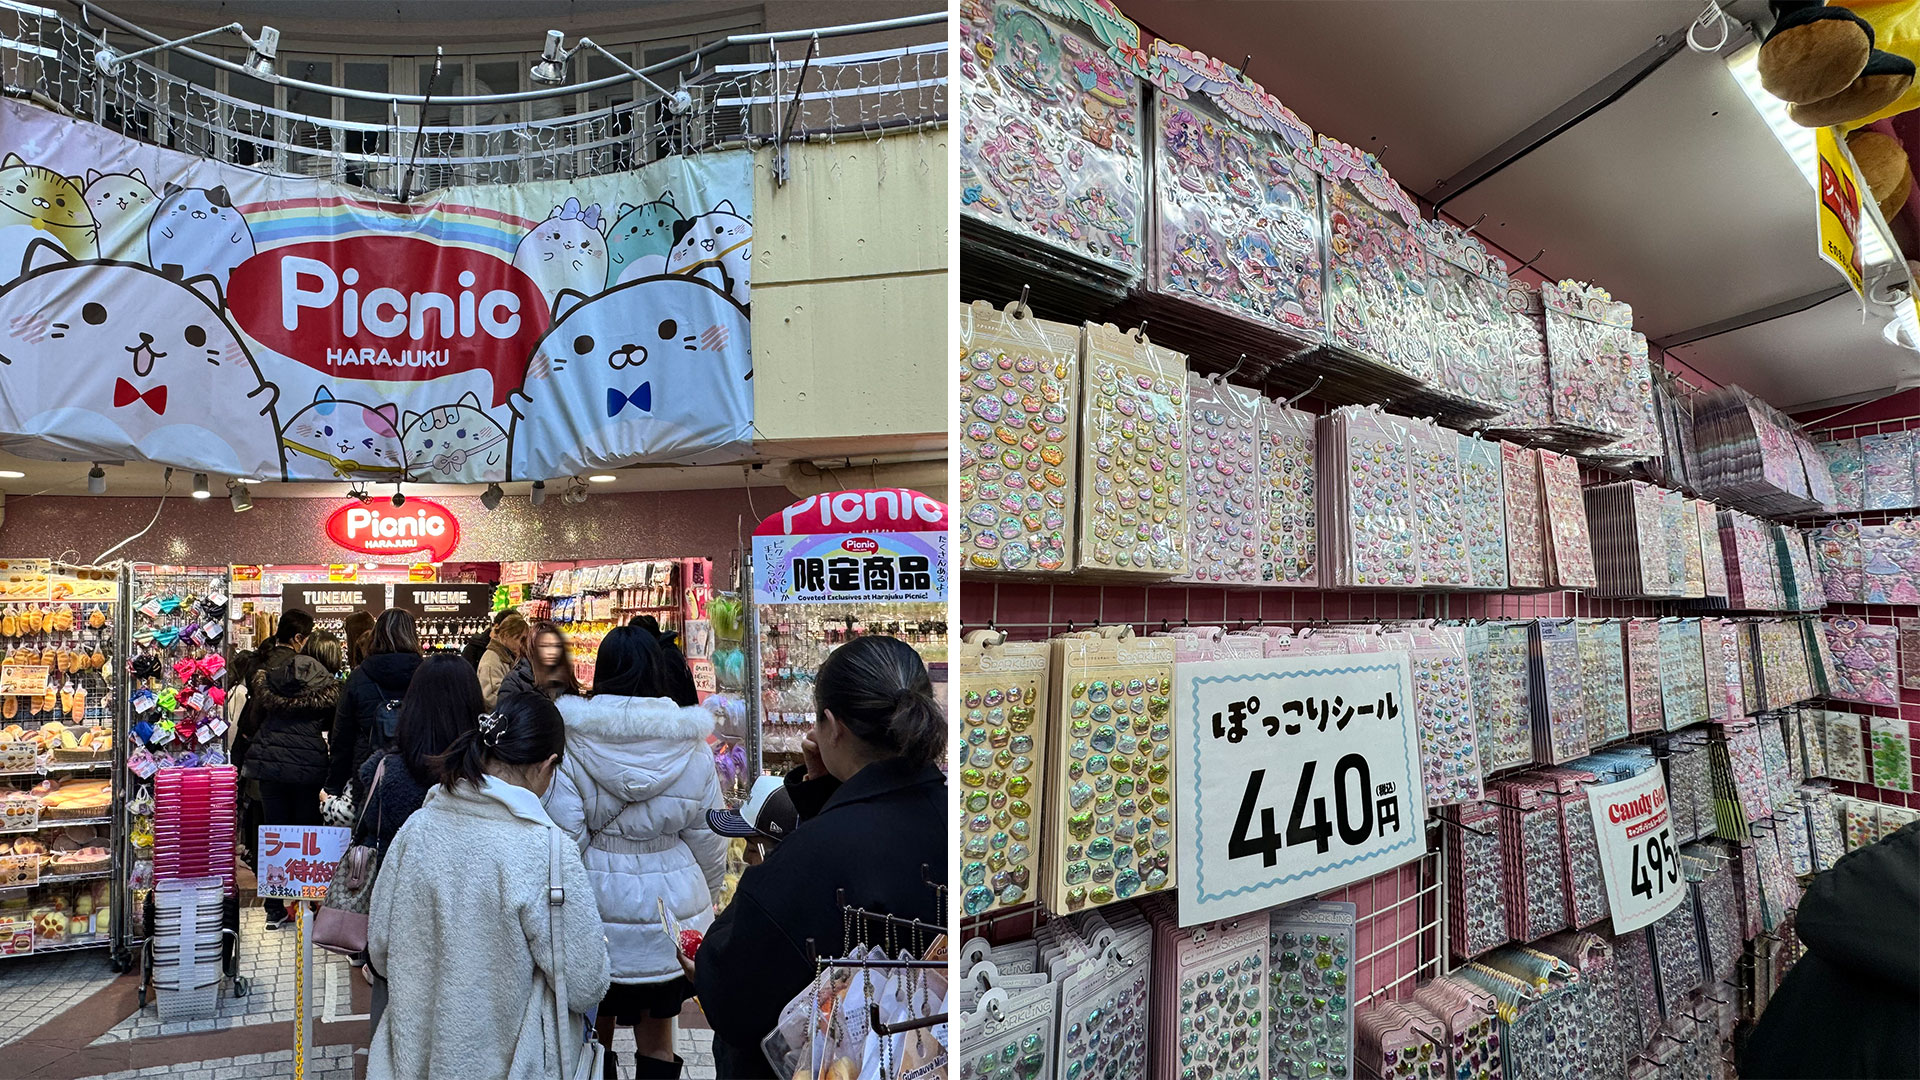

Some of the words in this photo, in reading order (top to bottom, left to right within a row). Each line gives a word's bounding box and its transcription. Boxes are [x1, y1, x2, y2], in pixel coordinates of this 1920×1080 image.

[280, 256, 521, 340] Picnic
[326, 347, 450, 368] HARAJUKU
[347, 509, 445, 539] Picnic
[365, 540, 417, 548] HARAJUKU
[847, 540, 875, 548] Picnic
[793, 556, 931, 592] 限定商品
[303, 591, 367, 605] TUNEME.
[413, 591, 471, 604] TUNEME.
[872, 593, 904, 601] Harajuku
[905, 592, 929, 600] Picnic!
[1211, 692, 1398, 744] ぽっこりシール
[1608, 793, 1653, 824] Candy
[285, 857, 340, 884] 待機
